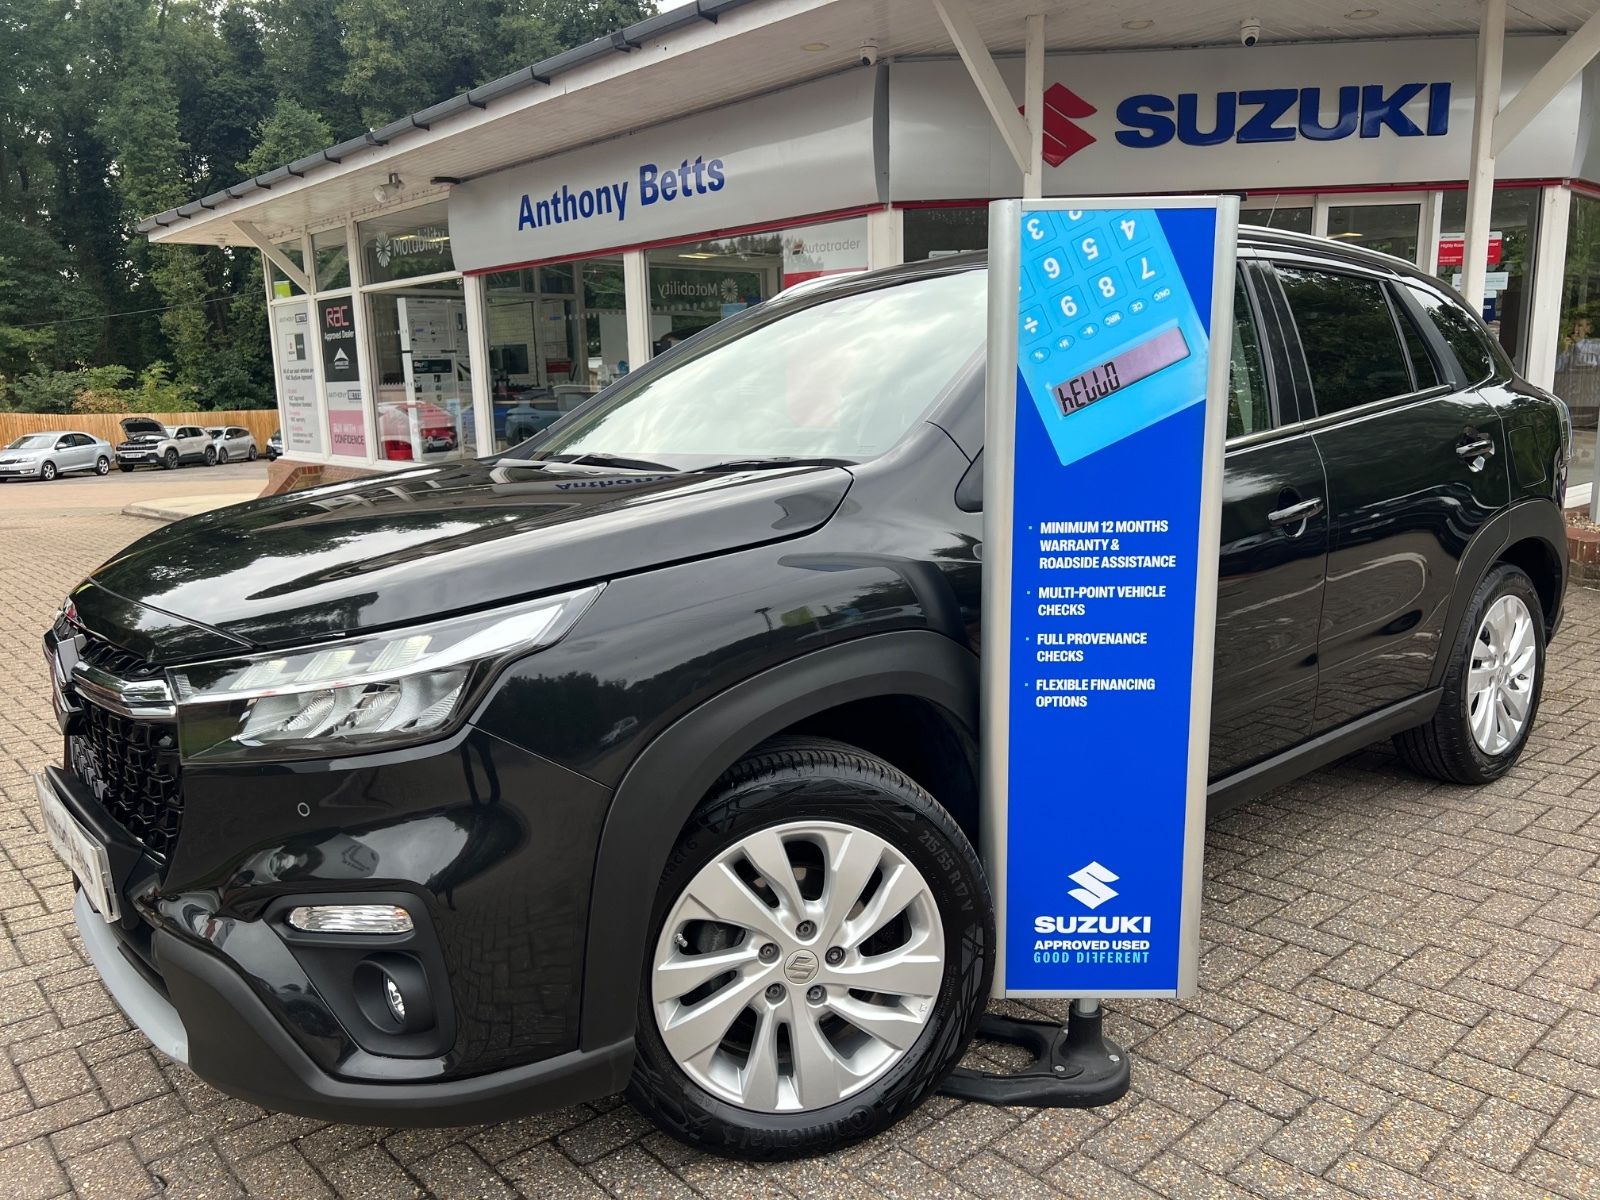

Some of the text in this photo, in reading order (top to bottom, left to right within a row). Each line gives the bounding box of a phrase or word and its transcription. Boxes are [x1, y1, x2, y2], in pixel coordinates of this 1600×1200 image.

[1115, 82, 1451, 148] SUZUKI
[518, 156, 725, 231] Anthony Betts
[1027, 218, 1044, 240] 3
[1120, 219, 1135, 240] 4
[393, 226, 445, 256] Motability
[802, 239, 860, 253] Autotrader
[1082, 237, 1098, 260] 5
[1141, 257, 1155, 280] 7
[1098, 276, 1115, 298] 8
[334, 434, 364, 445] CONFIDENCE
[1040, 520, 1168, 534] MINIMUM 12 MONTHS
[1040, 539, 1119, 551] WARRANTY &
[1039, 555, 1176, 569] ROADSIDE ASSISTANCE
[1038, 586, 1166, 598] MULTI-POINT VEHICLE
[1038, 604, 1085, 616] CHECKS
[1037, 632, 1147, 645] FULL PROVENANCE
[1036, 650, 1084, 662] CHECKS
[1036, 678, 1155, 691] FLEXIBLE FINANCING
[1036, 695, 1087, 707] OPTIONS
[917, 829, 974, 911] 215/55 R 17 V
[1034, 916, 1151, 934] SUZUKI
[1034, 940, 1150, 950] APPROVED USED
[1034, 951, 1149, 963] GOOD DIFFERENT
